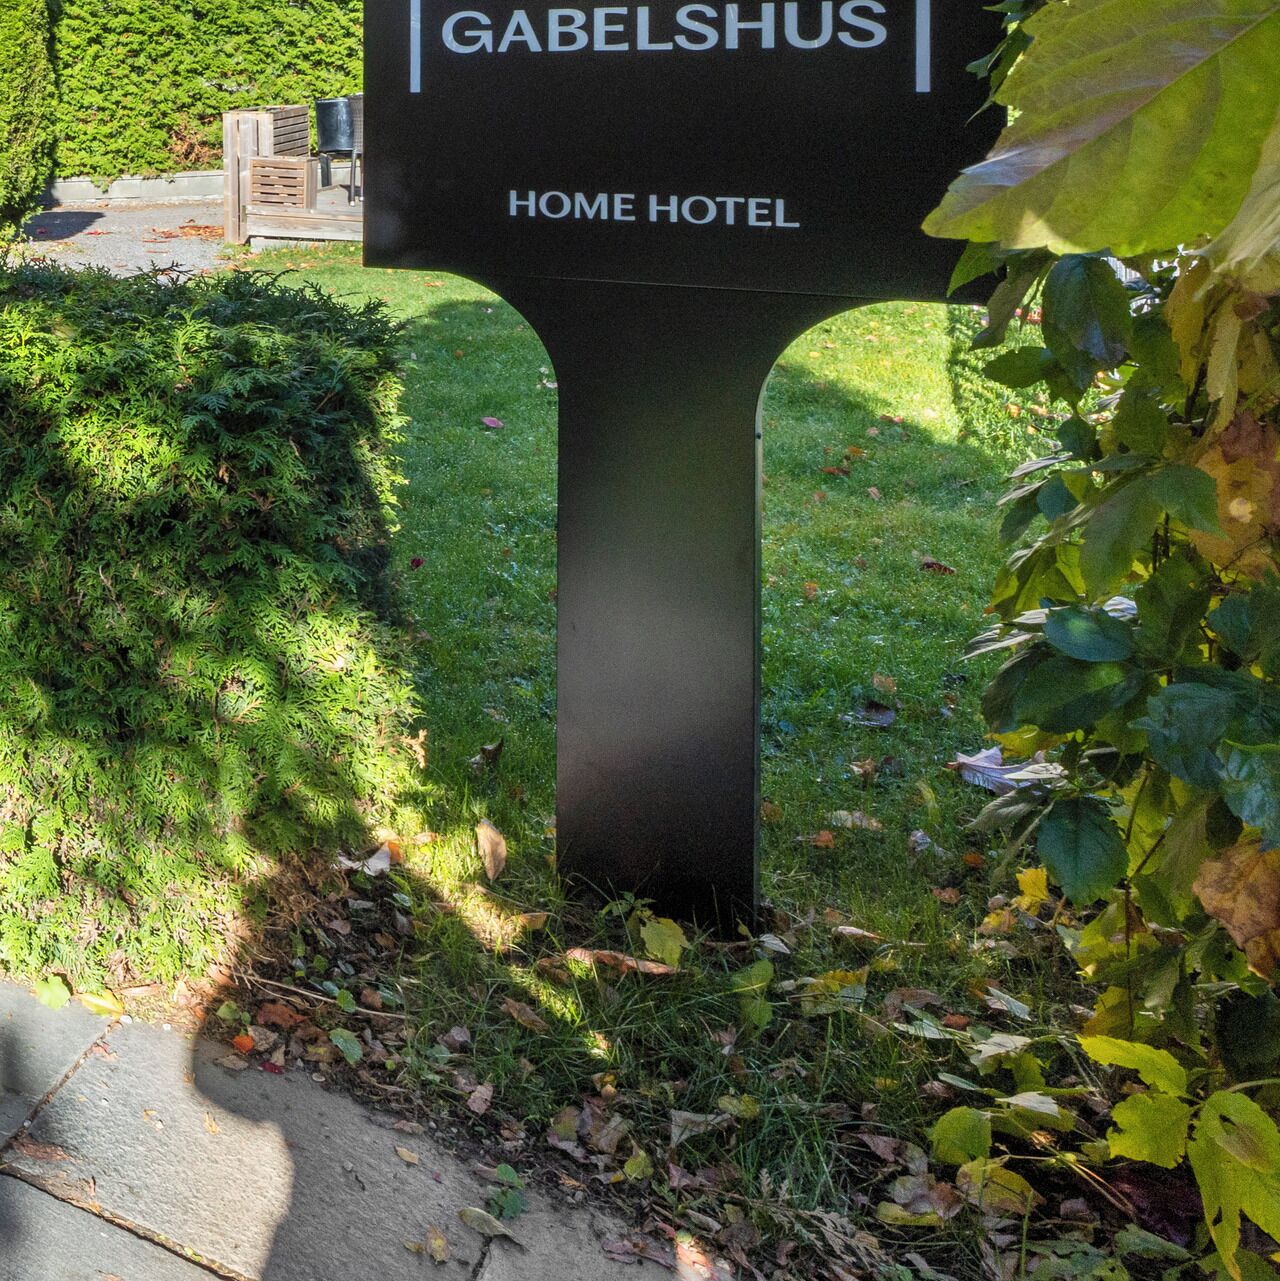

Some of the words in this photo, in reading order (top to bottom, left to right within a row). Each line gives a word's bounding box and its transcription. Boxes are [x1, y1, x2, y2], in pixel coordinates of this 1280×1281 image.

[441, 0, 887, 54] GABELSHUS
[509, 190, 636, 221] HOME
[649, 194, 800, 228] HOTEL
